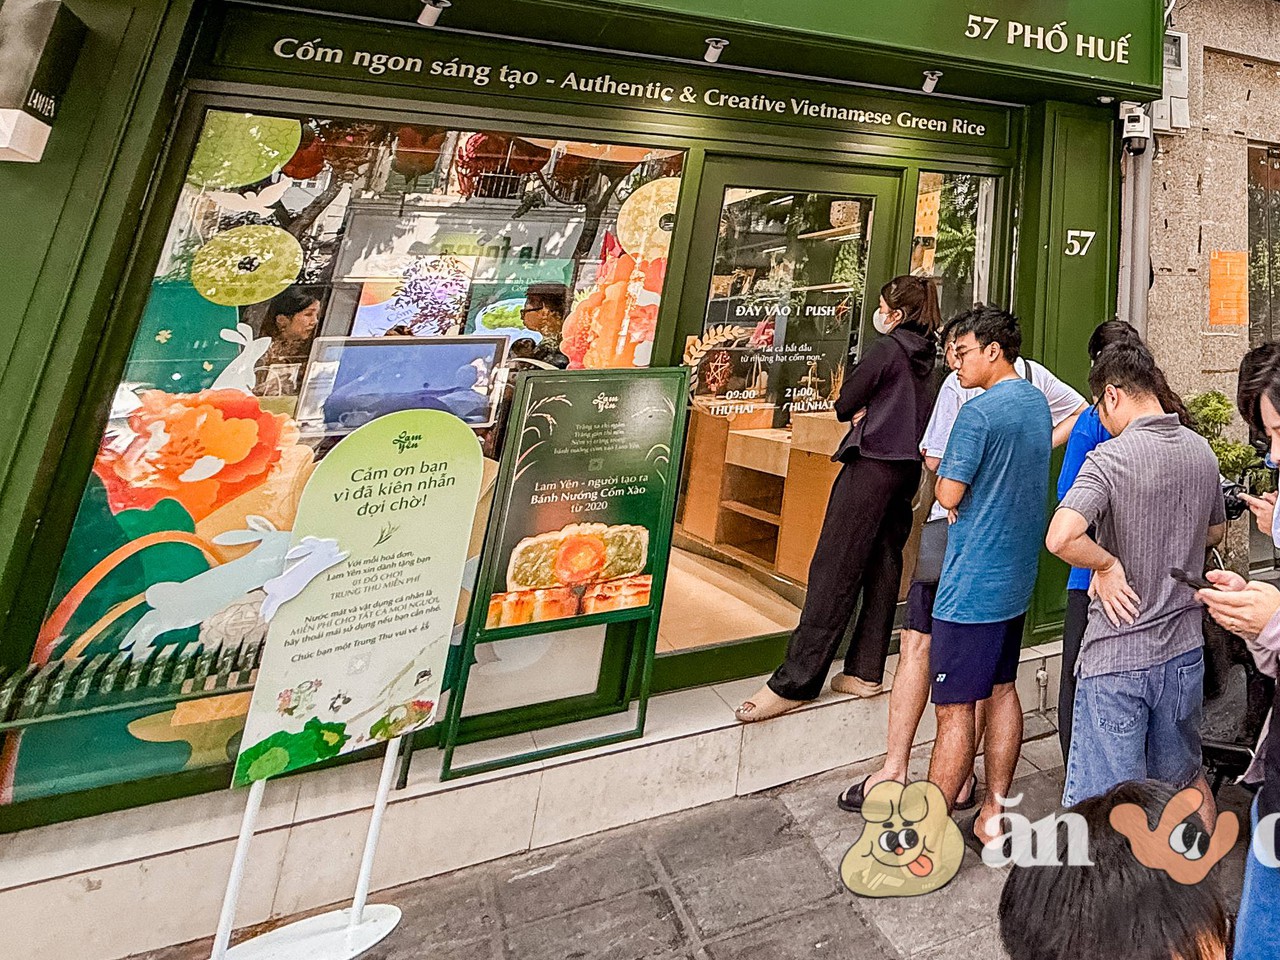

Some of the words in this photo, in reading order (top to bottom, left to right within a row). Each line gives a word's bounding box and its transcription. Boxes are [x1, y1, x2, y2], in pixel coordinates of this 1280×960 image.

[965, 14, 999, 40] 57
[1007, 21, 1068, 53] PHỐ
[1076, 33, 1132, 64] HUẾ
[273, 38, 343, 63] Cốm
[352, 50, 422, 75] ngon
[430, 58, 492, 86] sáng
[499, 65, 538, 88] tạo
[560, 72, 673, 102] Authentic
[679, 86, 698, 104] &
[704, 88, 786, 113] Creative
[791, 98, 892, 125] Vietnamese
[897, 112, 947, 132] Green
[952, 119, 985, 136] Rice
[1065, 230, 1096, 256] 57
[766, 306, 790, 316] VÀO
[806, 306, 836, 316] PUSH
[592, 392, 618, 404] Lam
[726, 390, 756, 400] 09:00
[785, 388, 813, 398] 21:00
[392, 431, 422, 445] Lam
[351, 467, 387, 482] Cảm
[393, 466, 415, 476] ơn
[420, 460, 448, 476] bạn
[334, 488, 349, 502] vì
[353, 485, 372, 500] đã
[378, 481, 412, 496] kiên
[418, 473, 455, 490] nhẫn
[535, 482, 556, 492] Lam
[560, 480, 578, 489] Yên
[588, 476, 618, 488] người
[621, 475, 636, 485] tạo
[530, 492, 558, 504] Bánh
[560, 490, 598, 501] Nướng
[600, 486, 624, 497] Cốm
[627, 485, 646, 495] Xào
[357, 500, 385, 517] đợi
[390, 494, 427, 512] chờ!
[571, 504, 583, 513] từ
[586, 501, 608, 512] 2020
[327, 572, 344, 581] Lam
[347, 569, 361, 577] Yên
[363, 566, 375, 574] xin
[416, 556, 430, 564] bạn
[330, 588, 360, 600] TRUNG
[364, 583, 382, 592] THU
[304, 613, 328, 622] Nước
[348, 606, 357, 614] và
[334, 616, 356, 626] CHO
[394, 612, 409, 621] bạn
[291, 652, 314, 662] Chúc
[316, 647, 332, 656] bạn
[334, 642, 352, 651] một
[354, 637, 376, 647] Trung
[378, 633, 393, 641] Thu
[395, 629, 406, 637] vui
